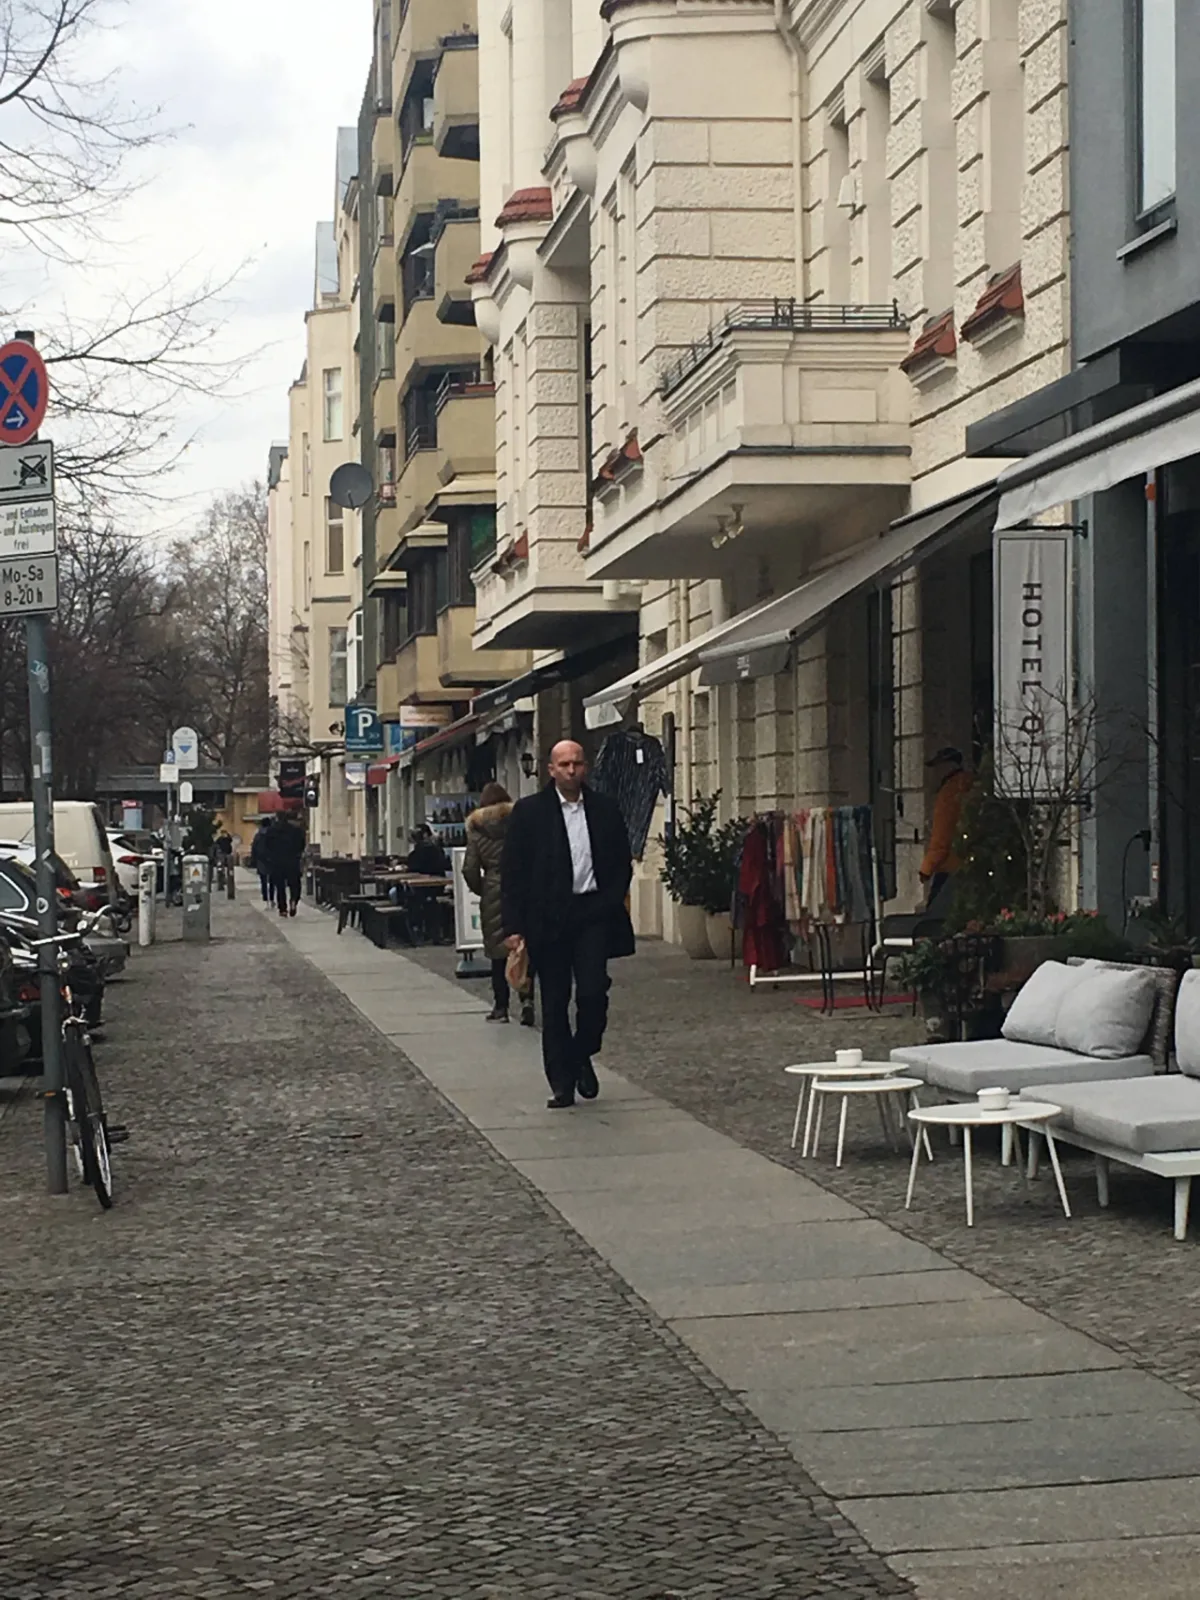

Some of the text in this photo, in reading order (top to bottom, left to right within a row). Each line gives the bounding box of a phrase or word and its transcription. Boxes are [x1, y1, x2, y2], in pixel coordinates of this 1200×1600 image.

[6, 508, 18, 521] und
[4, 521, 16, 536] und
[14, 538, 29, 550] frei
[2, 565, 44, 583] Mo-Sa
[4, 587, 43, 606] 8-20 h
[1022, 582, 1042, 695] HOTEL
[358, 713, 373, 737] P
